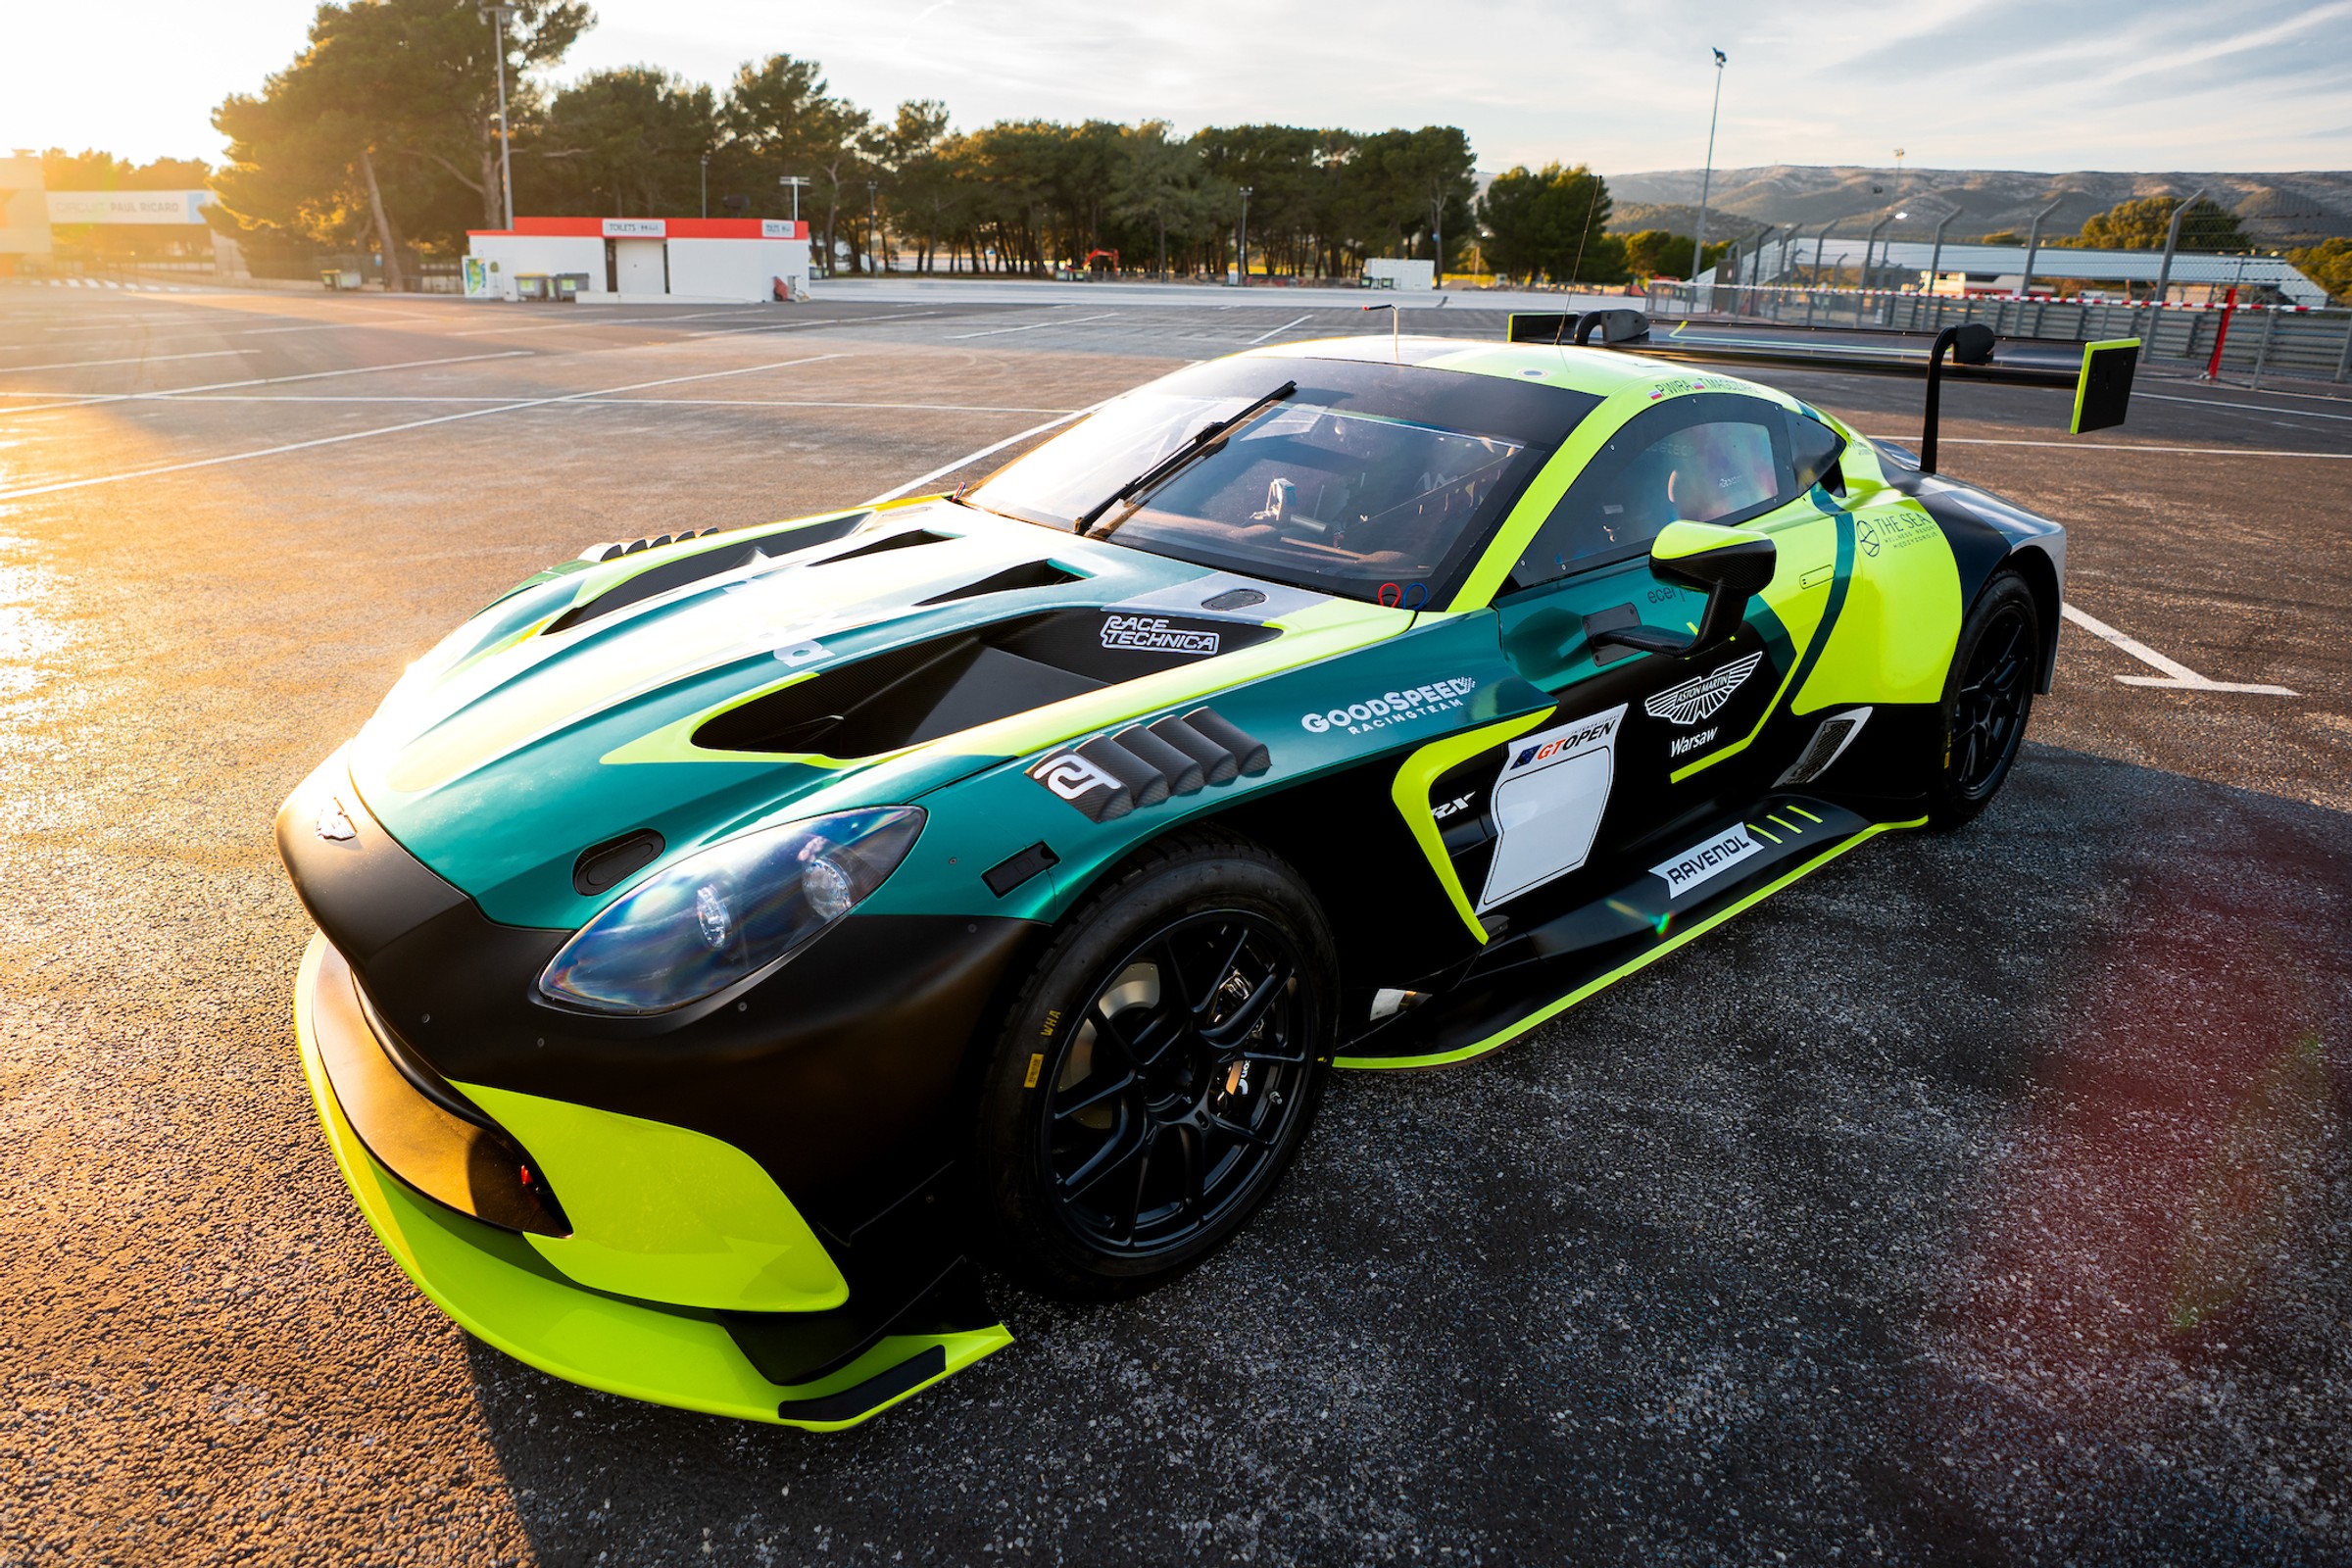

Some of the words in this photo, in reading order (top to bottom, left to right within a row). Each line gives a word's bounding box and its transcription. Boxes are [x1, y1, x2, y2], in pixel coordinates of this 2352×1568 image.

[110, 202, 136, 213] PAUL
[140, 202, 178, 213] RICARD
[1873, 515, 1903, 536] THE
[1900, 512, 1932, 529] SEA
[1102, 615, 1170, 634] RACE
[1105, 629, 1214, 651] TECHNICA
[1677, 686, 1702, 704] ASTON
[1701, 674, 1730, 693] MARTIN
[1301, 677, 1475, 733] GOODSPEED
[1670, 726, 1719, 758] Warsaw
[1667, 835, 1751, 885] RAVENOL
